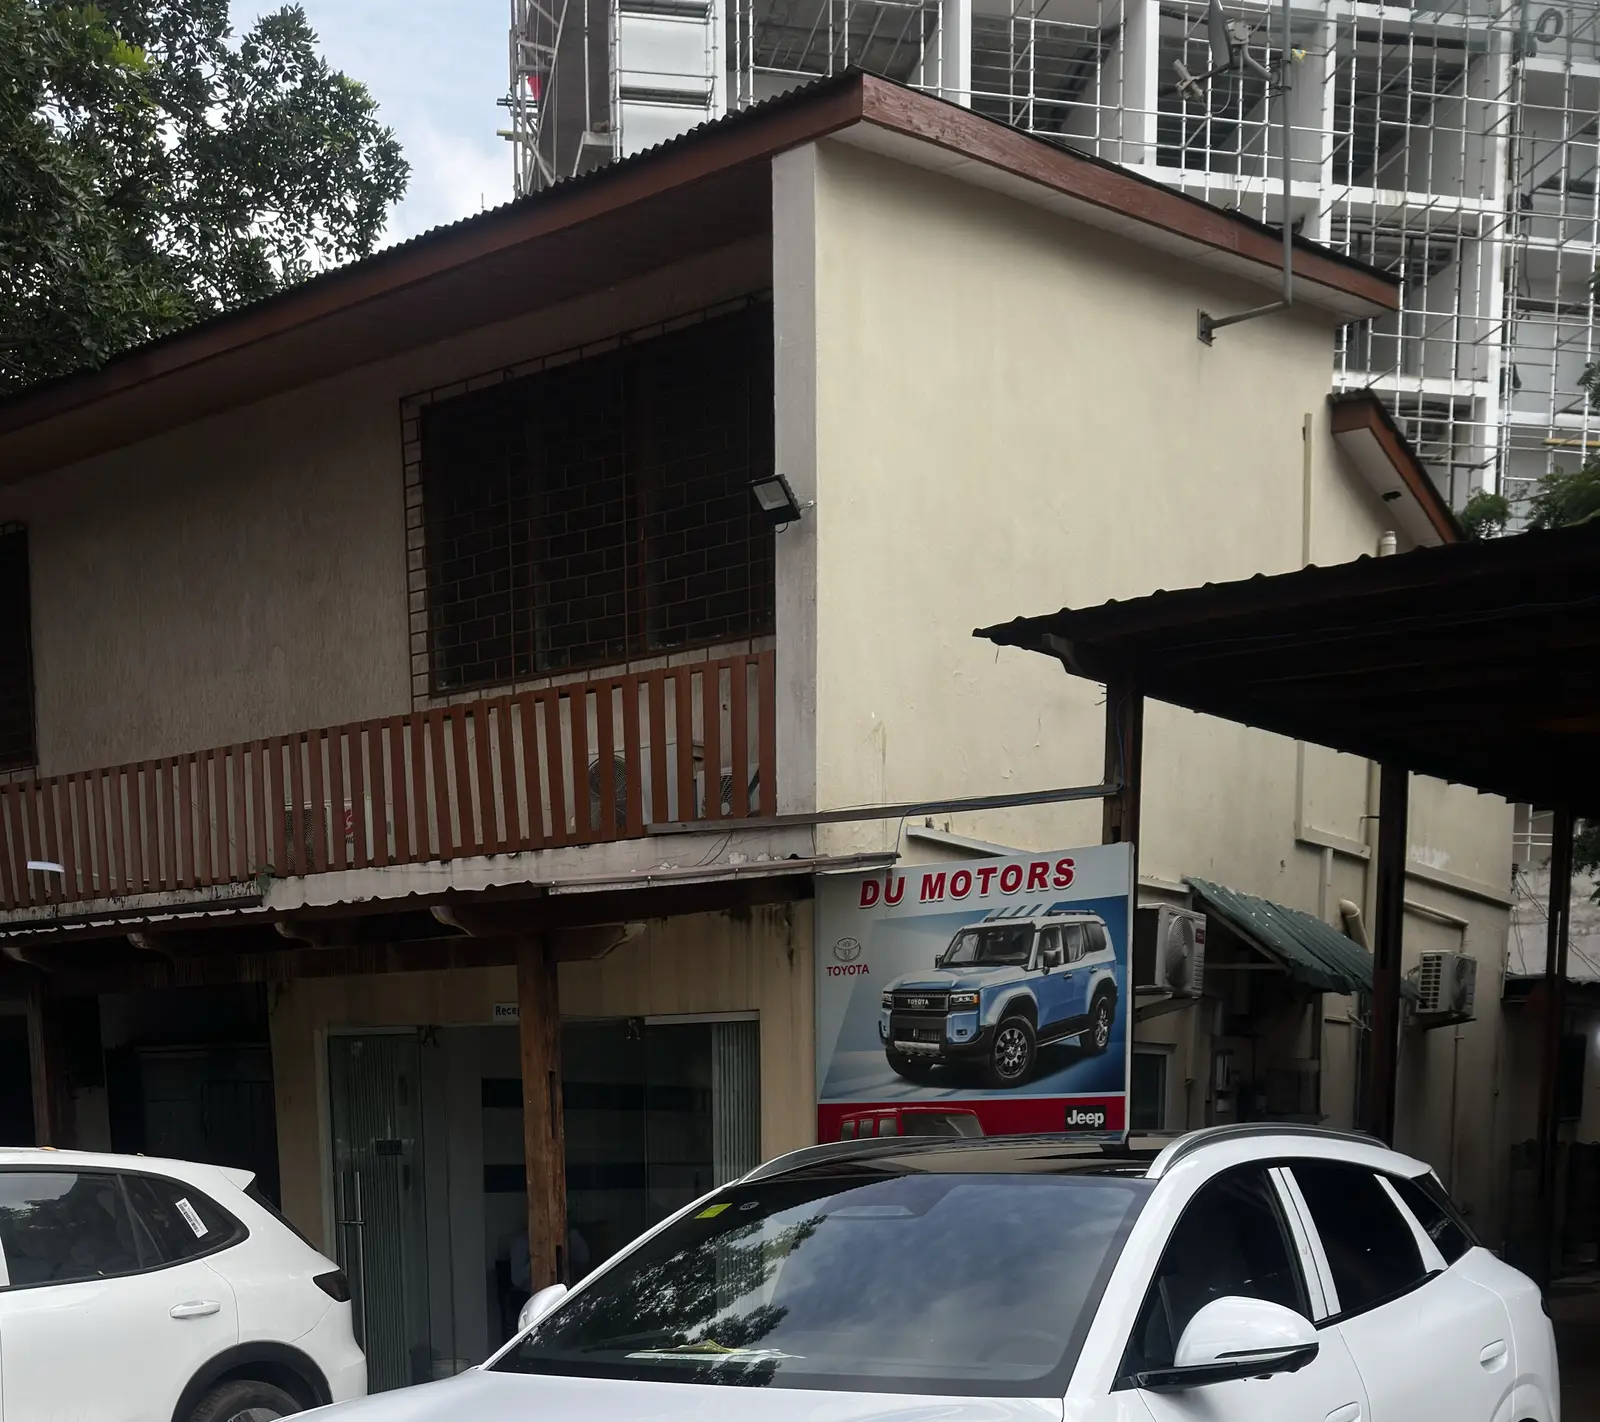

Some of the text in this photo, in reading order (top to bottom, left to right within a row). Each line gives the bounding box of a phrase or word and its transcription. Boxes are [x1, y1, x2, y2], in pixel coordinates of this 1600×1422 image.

[859, 858, 1076, 909] DU MOTORS
[826, 963, 870, 977] TOYOTA
[1067, 1109, 1105, 1128] Jeep
